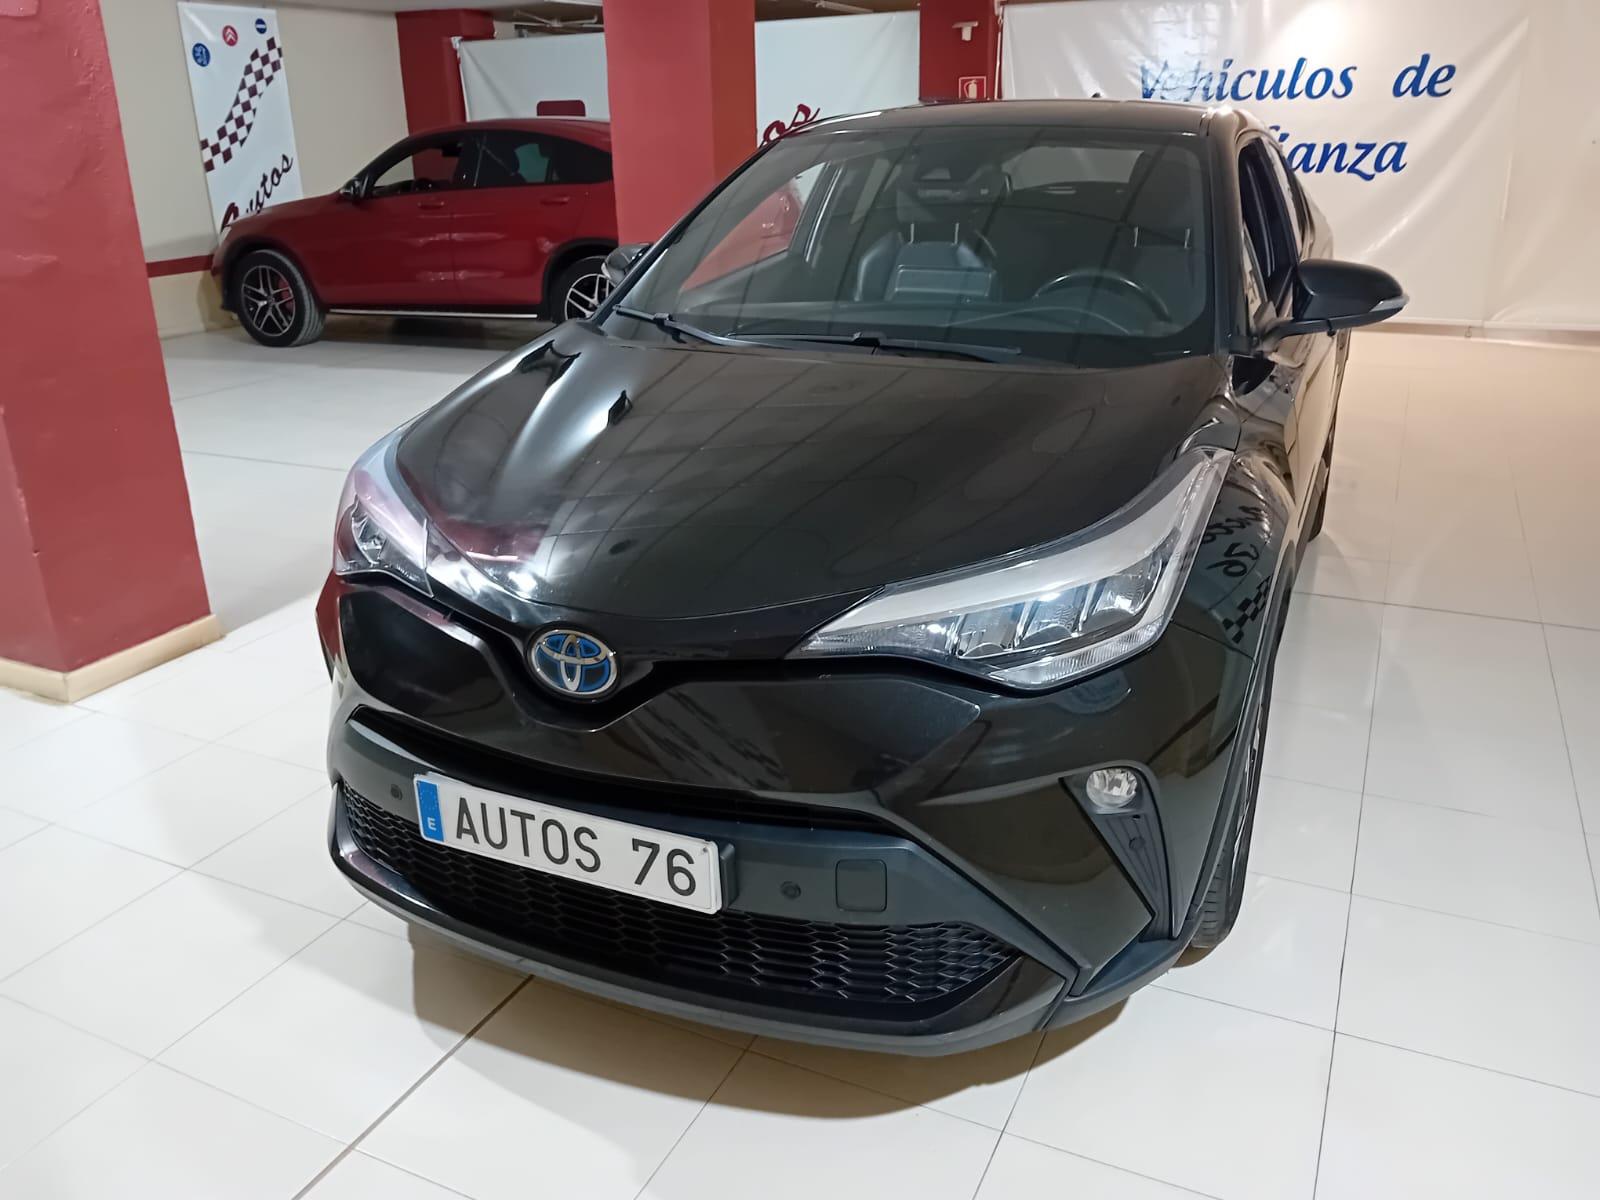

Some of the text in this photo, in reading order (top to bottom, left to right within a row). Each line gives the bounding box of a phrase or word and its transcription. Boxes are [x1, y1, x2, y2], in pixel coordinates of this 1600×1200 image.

[1391, 53, 1457, 98] de
[427, 816, 437, 831] E
[456, 797, 697, 897] AUTOS 76
